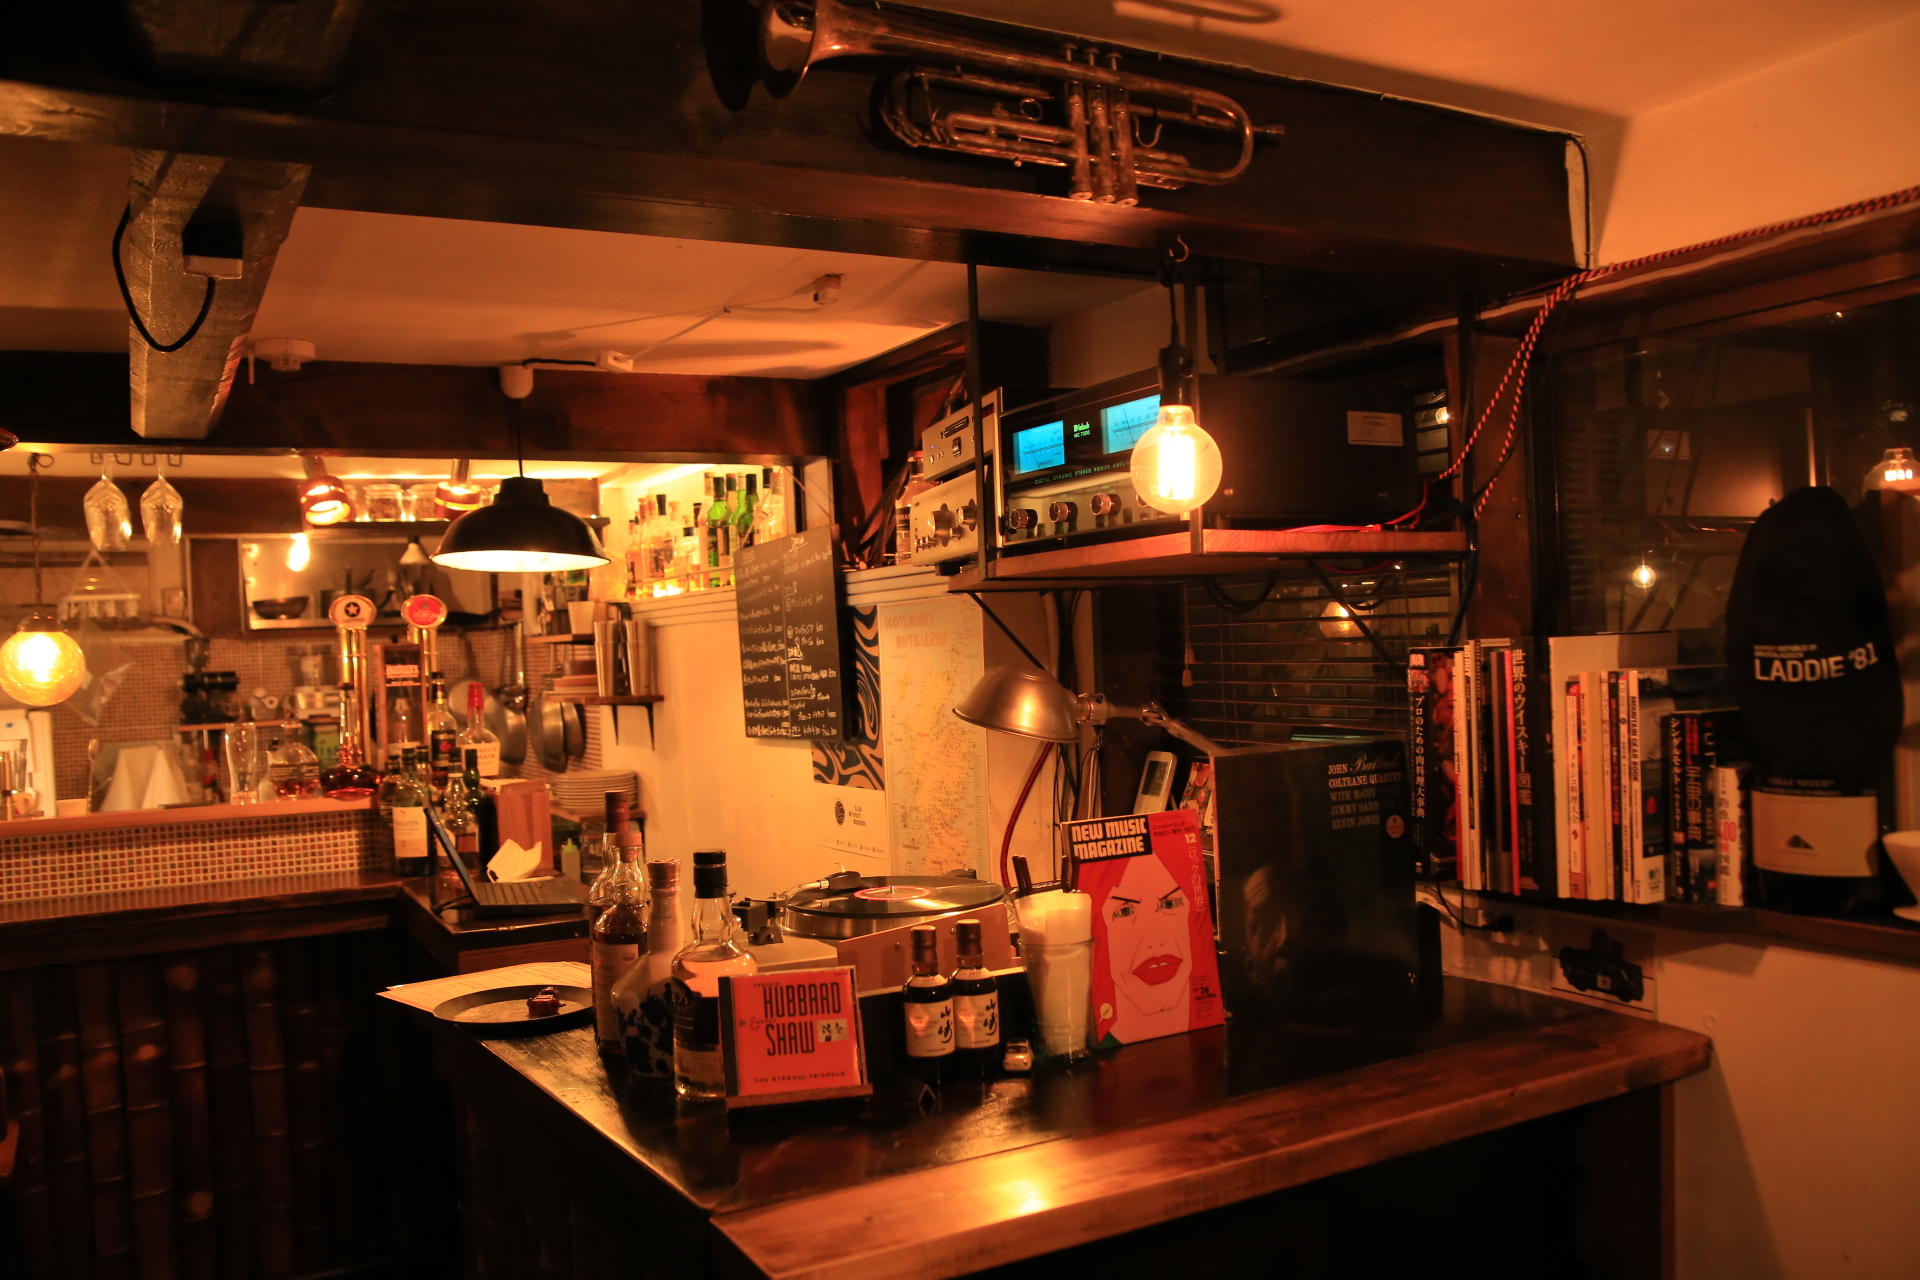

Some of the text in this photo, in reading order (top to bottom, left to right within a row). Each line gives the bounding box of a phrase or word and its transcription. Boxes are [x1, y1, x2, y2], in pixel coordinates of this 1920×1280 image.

[1034, 477, 1051, 485] DIGITAL
[1053, 472, 1073, 481] DYNAMIC
[1074, 467, 1092, 477] STEREO
[1094, 464, 1110, 473] POWER
[885, 612, 934, 630] SCOTLAND'S
[896, 631, 949, 649] DISTILLERIES
[1753, 655, 1845, 683] LADDIE
[1847, 641, 1879, 670] '81
[1629, 696, 1638, 736] MOUNTAIN
[1630, 738, 1639, 759] GEAR
[1327, 750, 1401, 775] JOHN Ballads
[1631, 761, 1640, 782] BOOK
[1328, 771, 1402, 789] COLTRANE QUARTET
[1329, 790, 1351, 802] WITH
[1353, 787, 1377, 799] McCOY
[1331, 802, 1357, 816] JIMMY
[1071, 817, 1147, 842] NEW MUSIC
[1332, 814, 1381, 830] ELVIN JONES
[1073, 835, 1145, 860] MAGAZINE
[1184, 832, 1197, 844] 12
[762, 981, 841, 1019] HUBBARD
[765, 1020, 815, 1056] SHAW
[772, 1074, 807, 1082] ETERNAL
[809, 1071, 846, 1079] TRIANGLE
